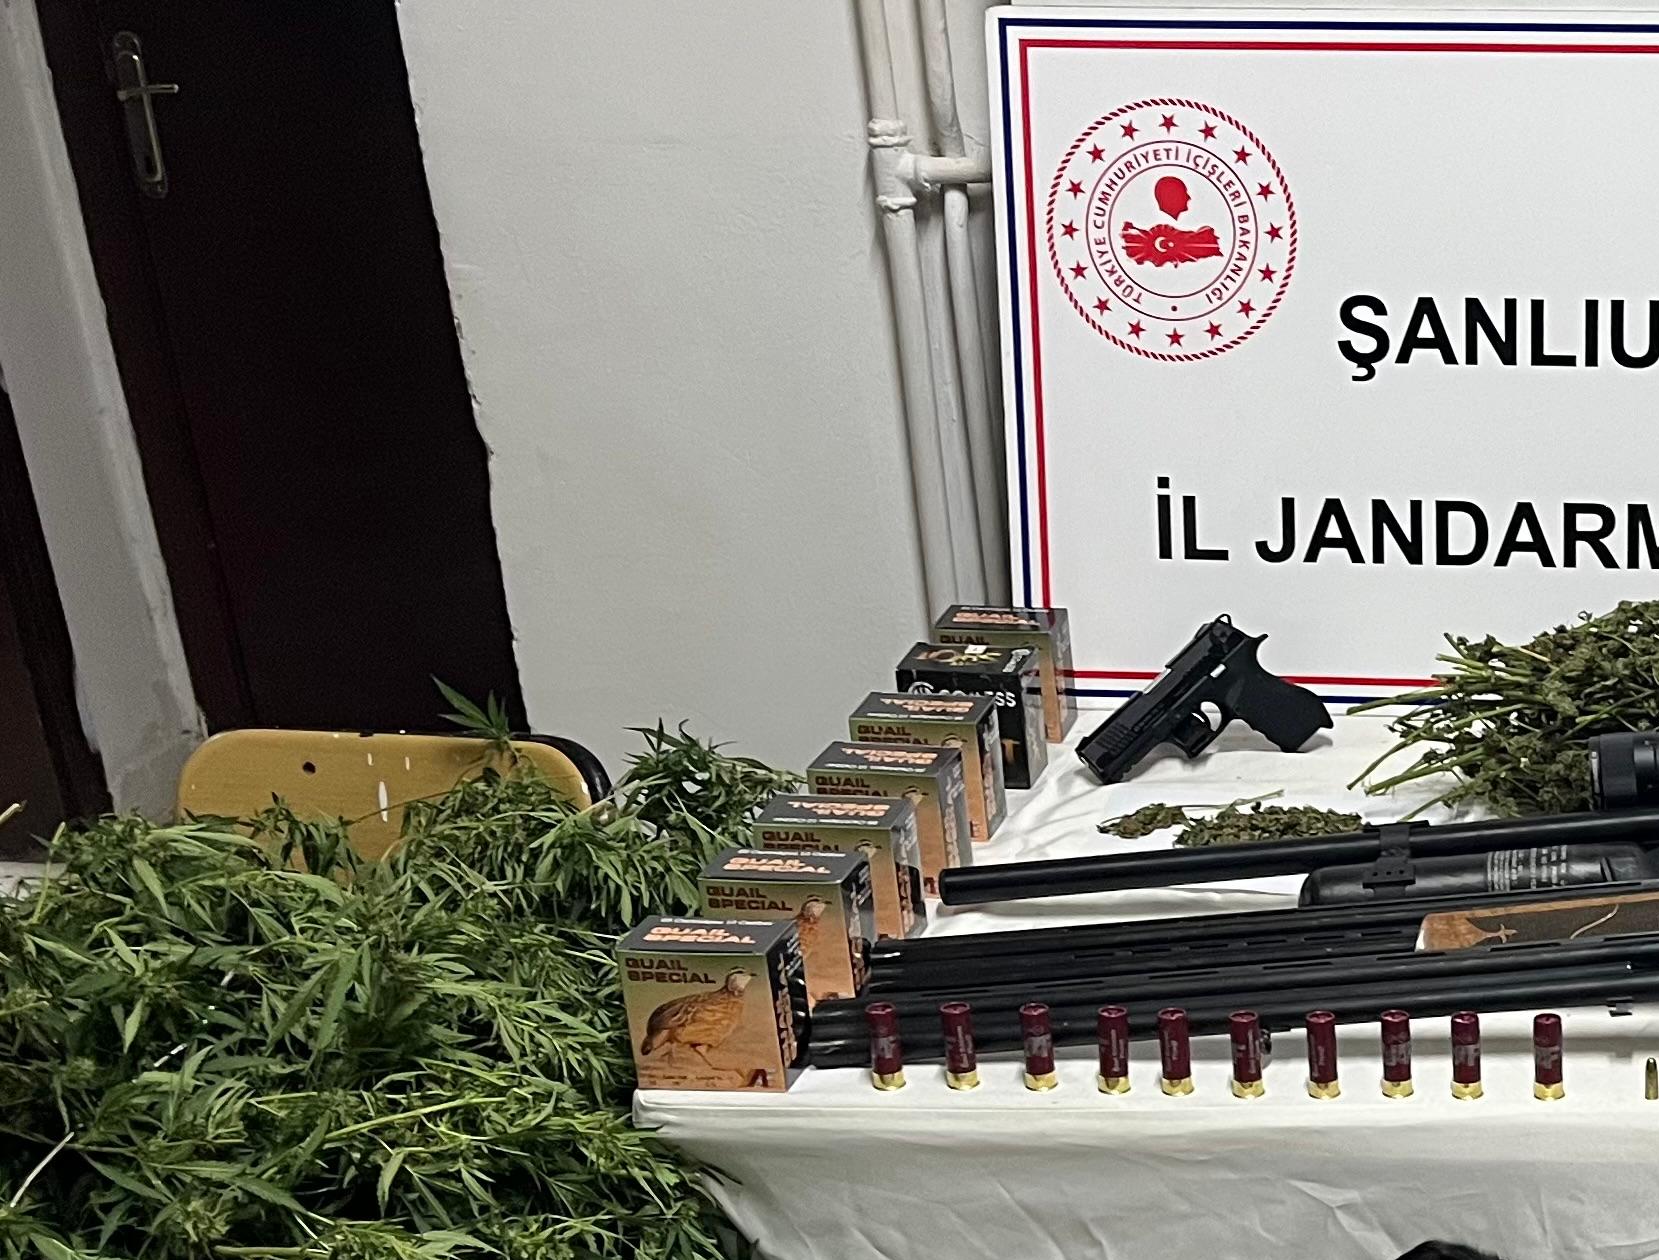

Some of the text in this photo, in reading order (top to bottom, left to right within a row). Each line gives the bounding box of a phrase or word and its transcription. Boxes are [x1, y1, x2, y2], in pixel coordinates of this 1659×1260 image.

[1094, 146, 1251, 304] TÜRKİYE CUMHURİYETİ İÇİŞLERİ BAKANLIĞI
[1158, 477, 1229, 560] İL
[940, 635, 989, 645] QUAIL
[857, 725, 911, 736] QUAIL
[815, 775, 870, 788] QUAIL
[762, 831, 821, 843] QUAIL
[706, 886, 768, 898] QUAIL
[708, 898, 793, 911] SPECIAL
[625, 957, 688, 971] QUAIL
[627, 971, 717, 984] SPECIAL
